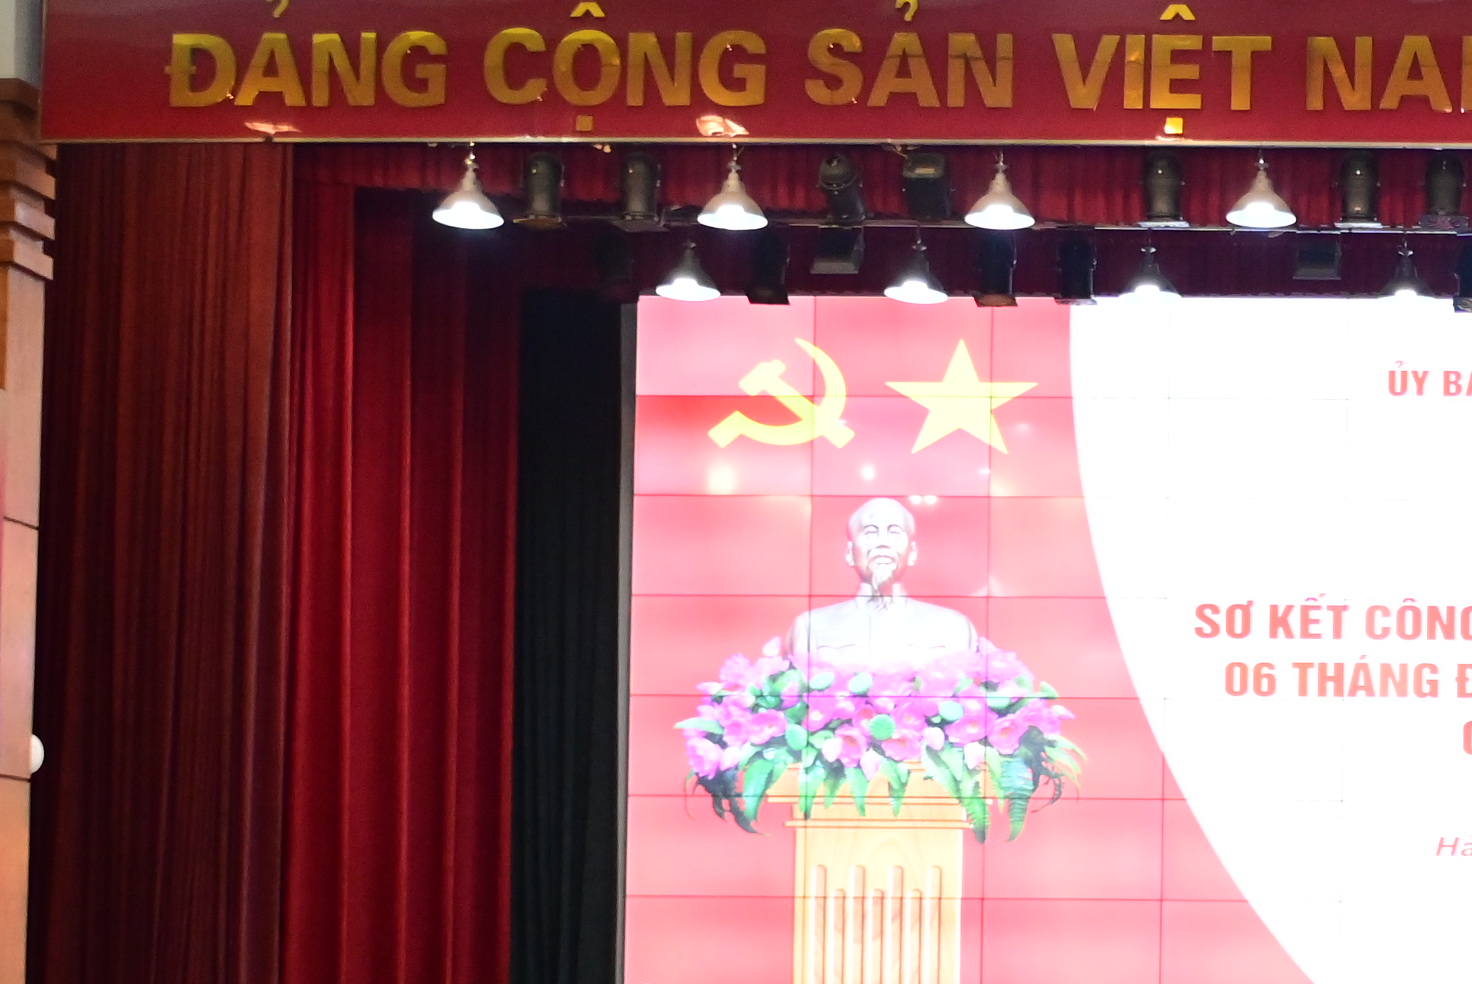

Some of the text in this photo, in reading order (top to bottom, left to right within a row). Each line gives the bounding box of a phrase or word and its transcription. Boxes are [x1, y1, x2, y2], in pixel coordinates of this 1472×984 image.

[165, 0, 448, 108] ĐẢNG
[484, 1, 767, 132] CỘNG
[804, 0, 1014, 108] SẢN
[1051, 4, 1273, 135] VIỆT
[1388, 361, 1430, 396] ỦY
[1195, 600, 1253, 639] SƠ
[1269, 593, 1349, 639] KẾT
[1225, 662, 1276, 697] 06
[1292, 655, 1438, 698] THÁNG
